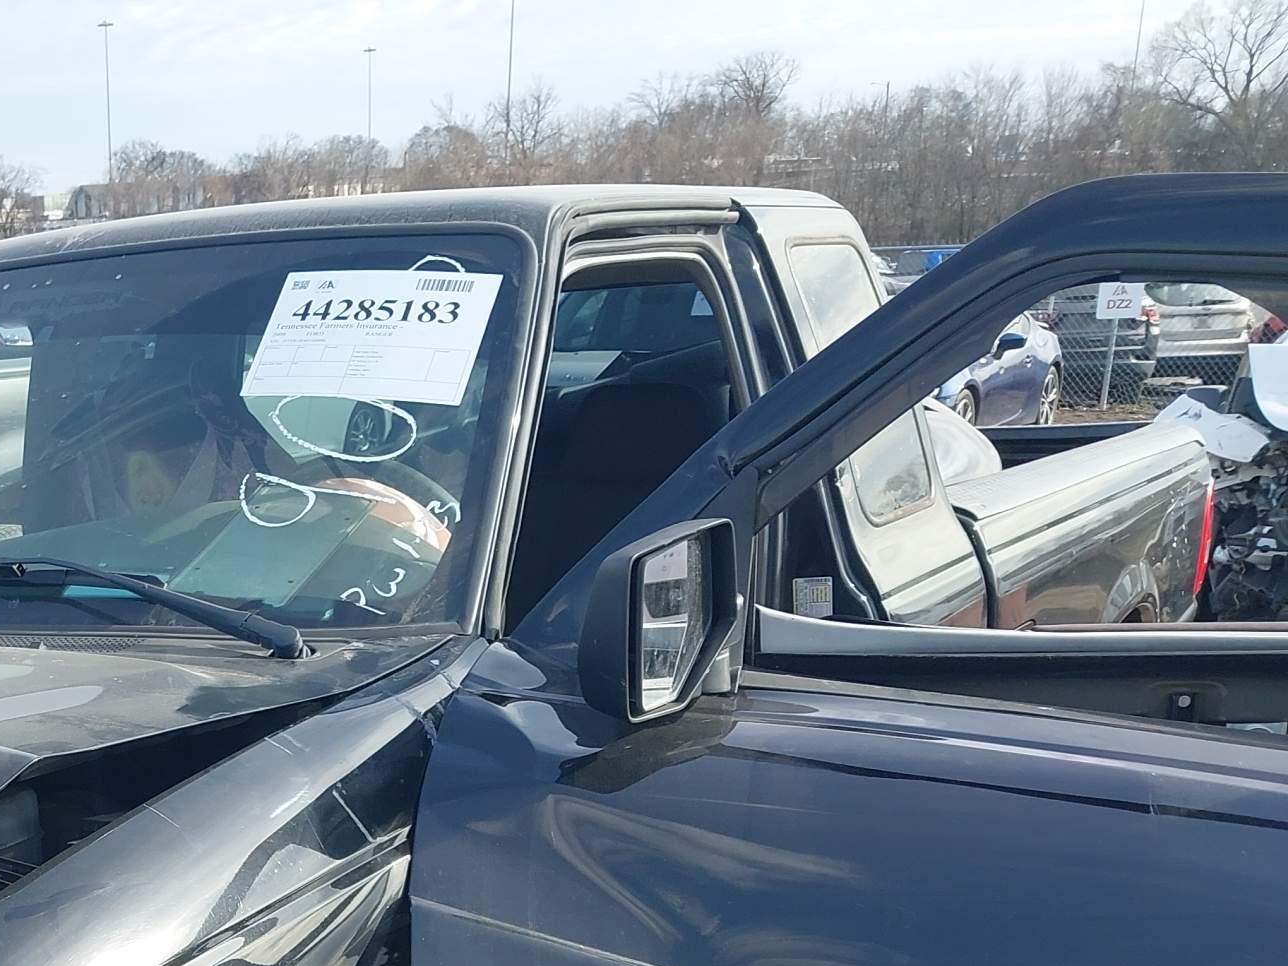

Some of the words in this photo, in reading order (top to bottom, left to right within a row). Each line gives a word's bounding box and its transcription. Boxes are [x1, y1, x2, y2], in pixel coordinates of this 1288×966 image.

[1107, 299, 1132, 309] DZ2
[292, 299, 461, 324] 44285183
[356, 322, 398, 330] Insurance
